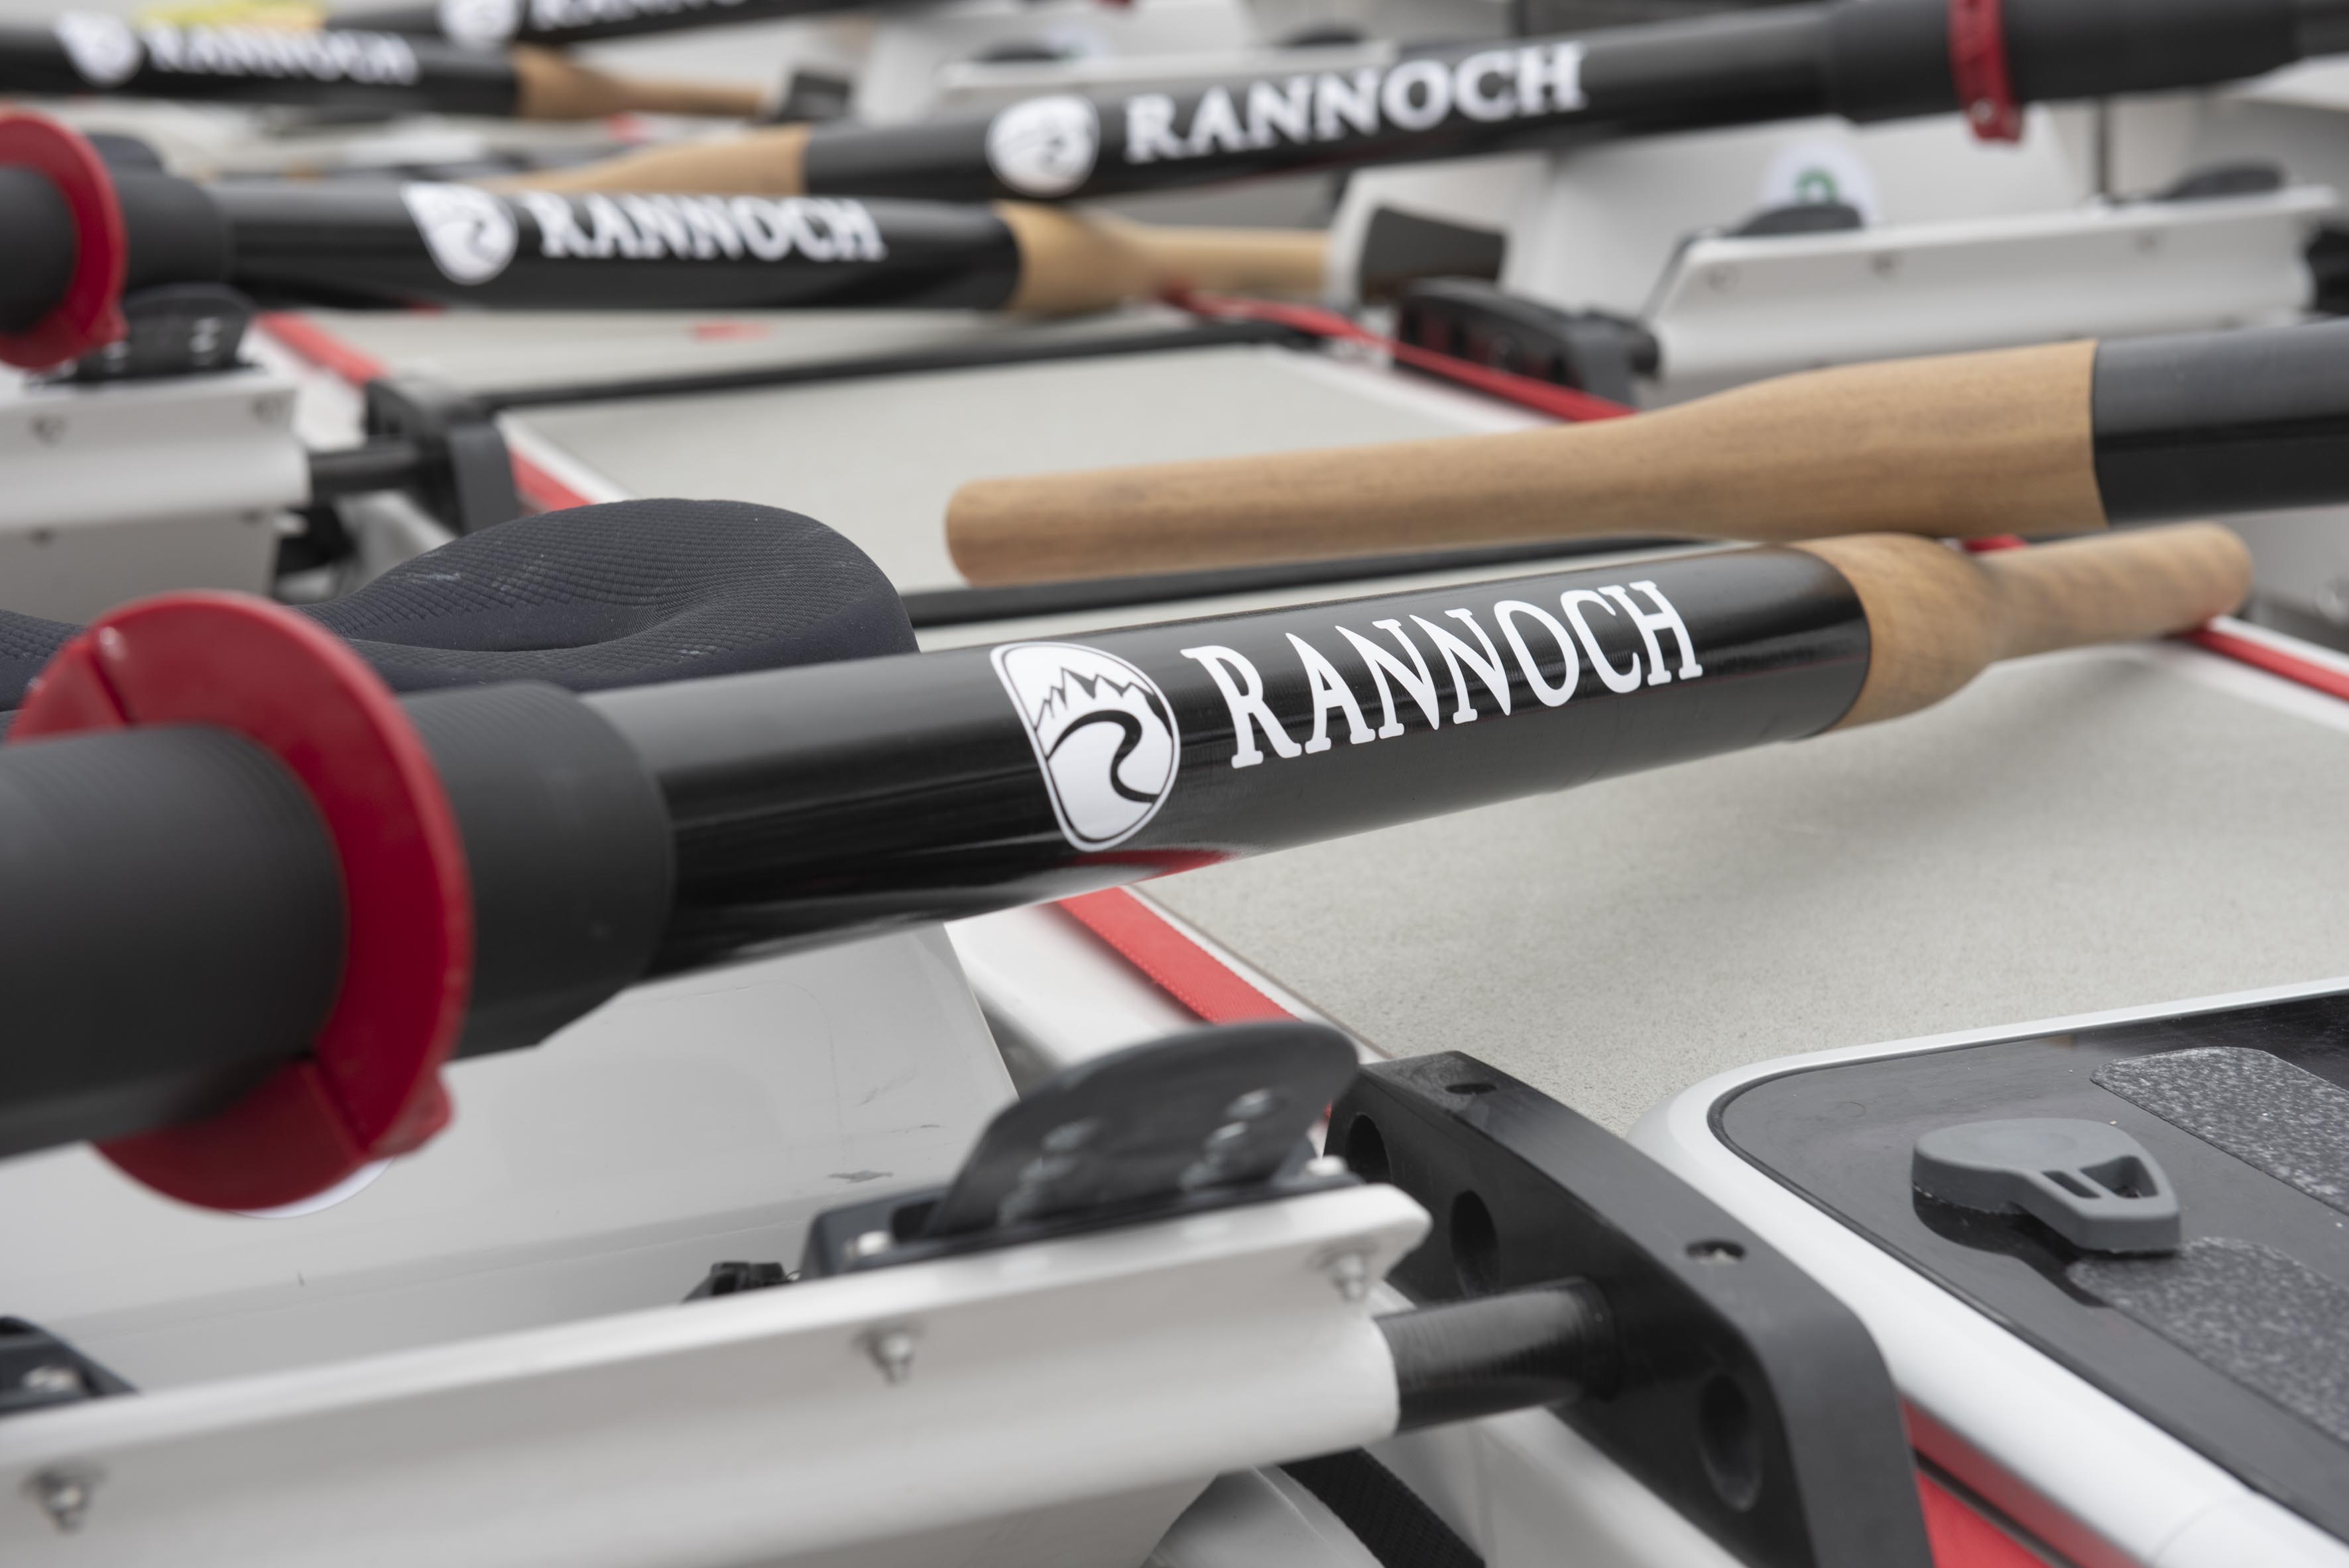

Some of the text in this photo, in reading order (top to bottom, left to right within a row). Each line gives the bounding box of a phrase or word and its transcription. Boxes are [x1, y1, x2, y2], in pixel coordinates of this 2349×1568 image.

[1124, 41, 1588, 163] RANNOCH
[520, 194, 887, 261] RANNOCH
[1180, 580, 1703, 769] RANNOCH
